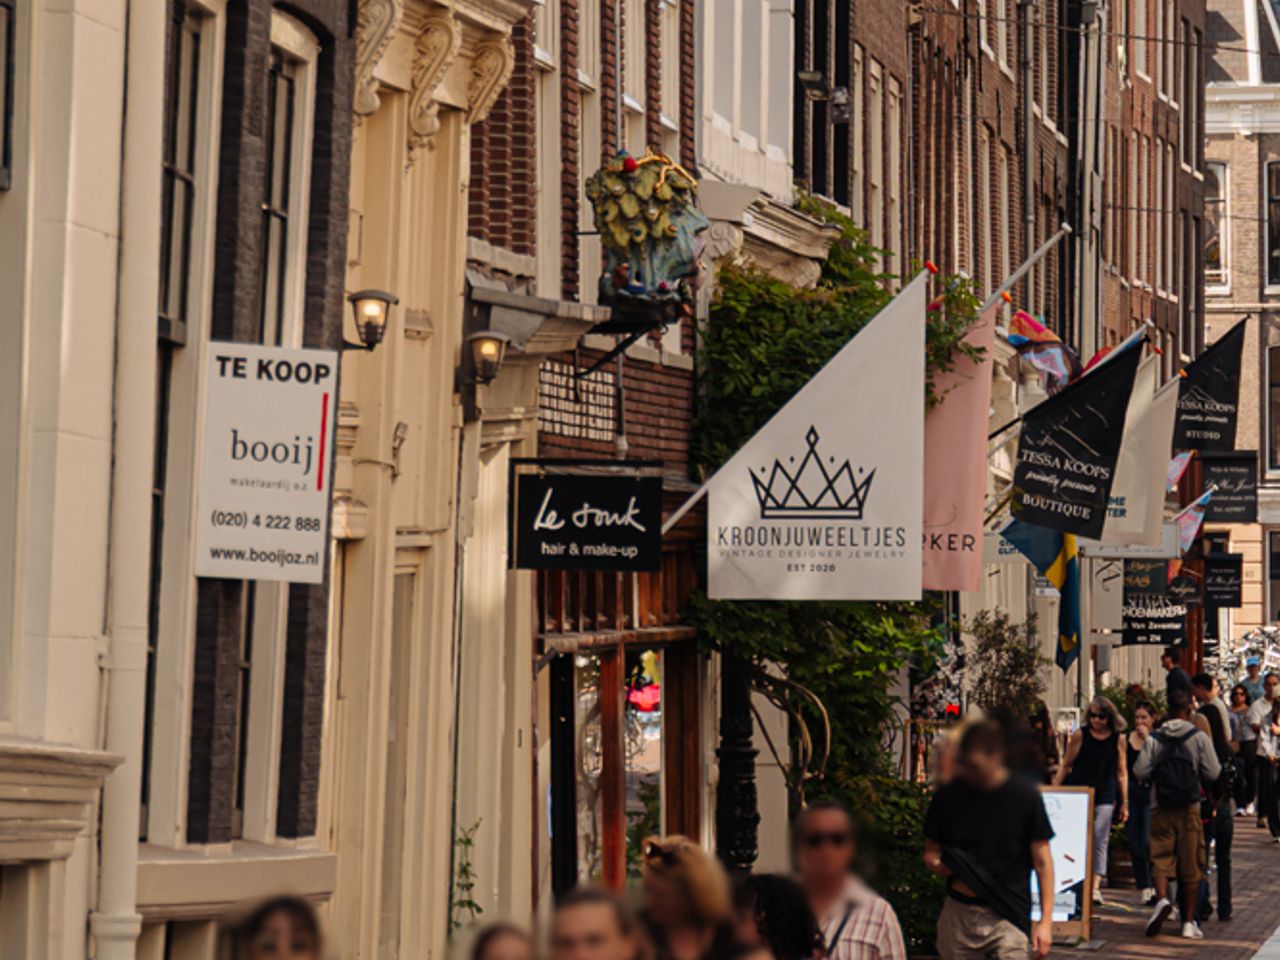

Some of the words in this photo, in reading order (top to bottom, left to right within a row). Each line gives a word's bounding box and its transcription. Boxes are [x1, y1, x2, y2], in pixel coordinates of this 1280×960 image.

[216, 356, 247, 378] TE
[256, 359, 330, 385] KOOP
[1186, 430, 1221, 440] STUDIO
[230, 429, 313, 476] booij
[1021, 449, 1061, 470] TESSA
[1063, 458, 1110, 480] KOOPS
[533, 488, 566, 531] Le
[1022, 493, 1092, 520] BOUTIQUE
[211, 510, 248, 527] (020)
[252, 515, 261, 528] 4
[265, 515, 291, 530] 222
[295, 517, 321, 531] 888
[717, 526, 906, 547] KROONJUWEELTJES
[210, 547, 319, 567] www.booijoz.nl
[541, 542, 566, 555] hair
[569, 542, 579, 556] &
[582, 544, 638, 558] make-up
[719, 549, 773, 558] VINTAGE
[779, 549, 843, 558] DESIGNER
[848, 550, 905, 559] JEWELRY
[787, 564, 806, 572] EST
[809, 564, 836, 572] 2020
